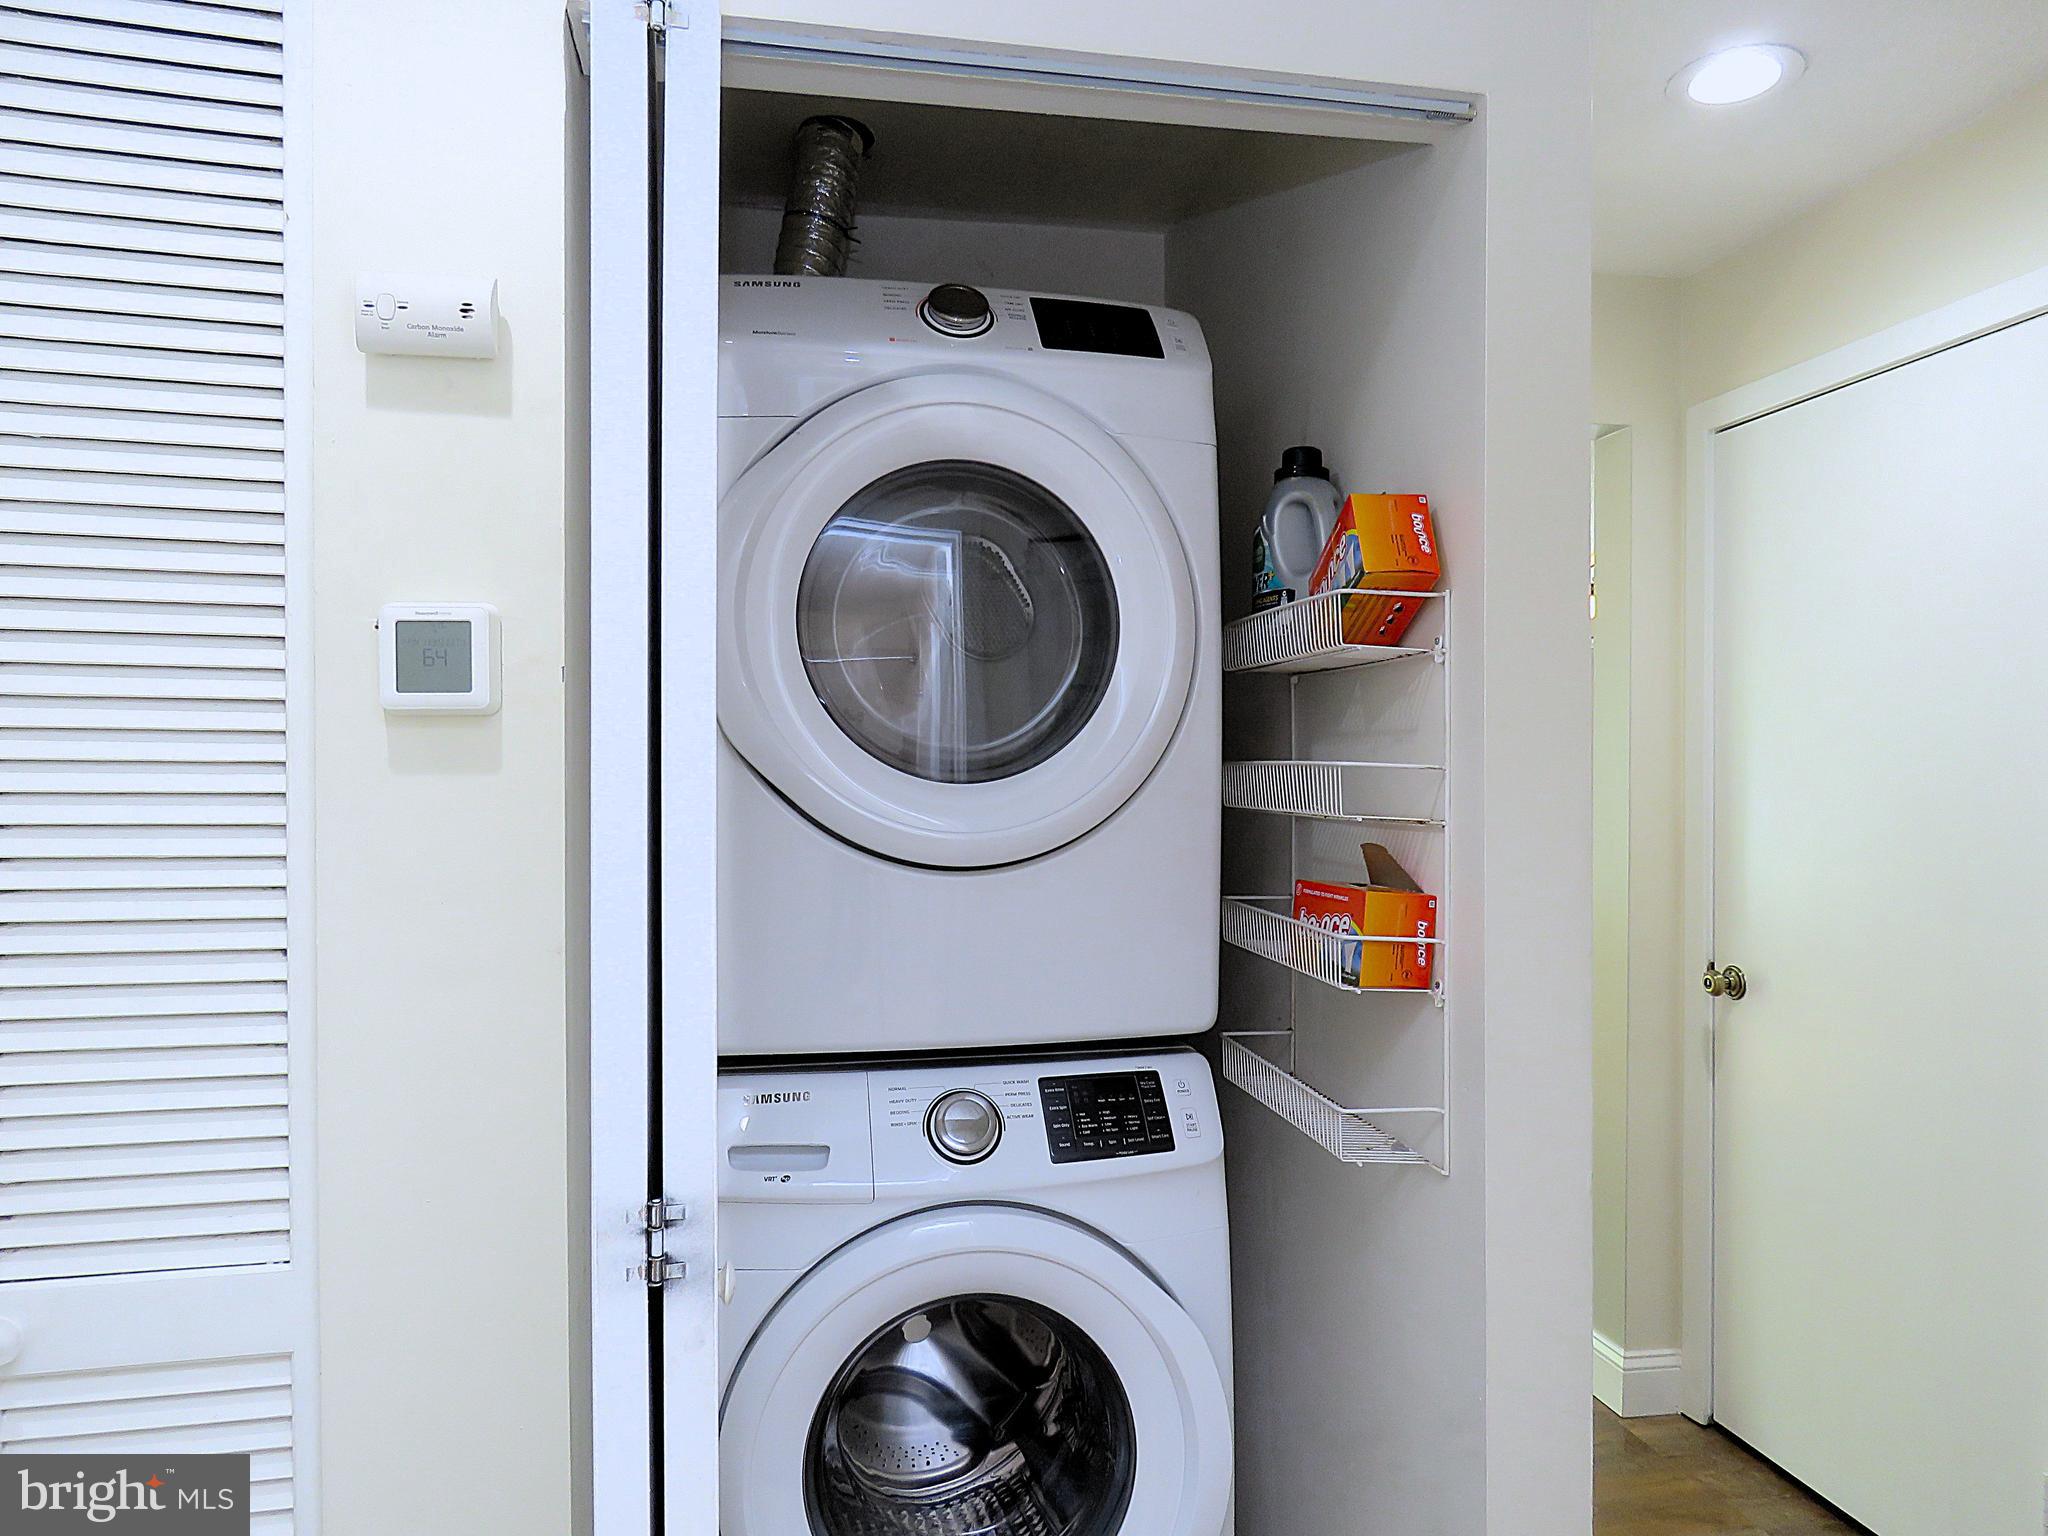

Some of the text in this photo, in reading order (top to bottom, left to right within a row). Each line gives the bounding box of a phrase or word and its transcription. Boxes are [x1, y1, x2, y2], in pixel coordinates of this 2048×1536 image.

[406, 323, 431, 331] Carbon
[427, 331, 447, 339] Alarm
[1411, 513, 1432, 554] bounce
[423, 648, 447, 667] 64
[1417, 920, 1428, 967] bonce
[743, 1091, 811, 1105] SAMSUNG
